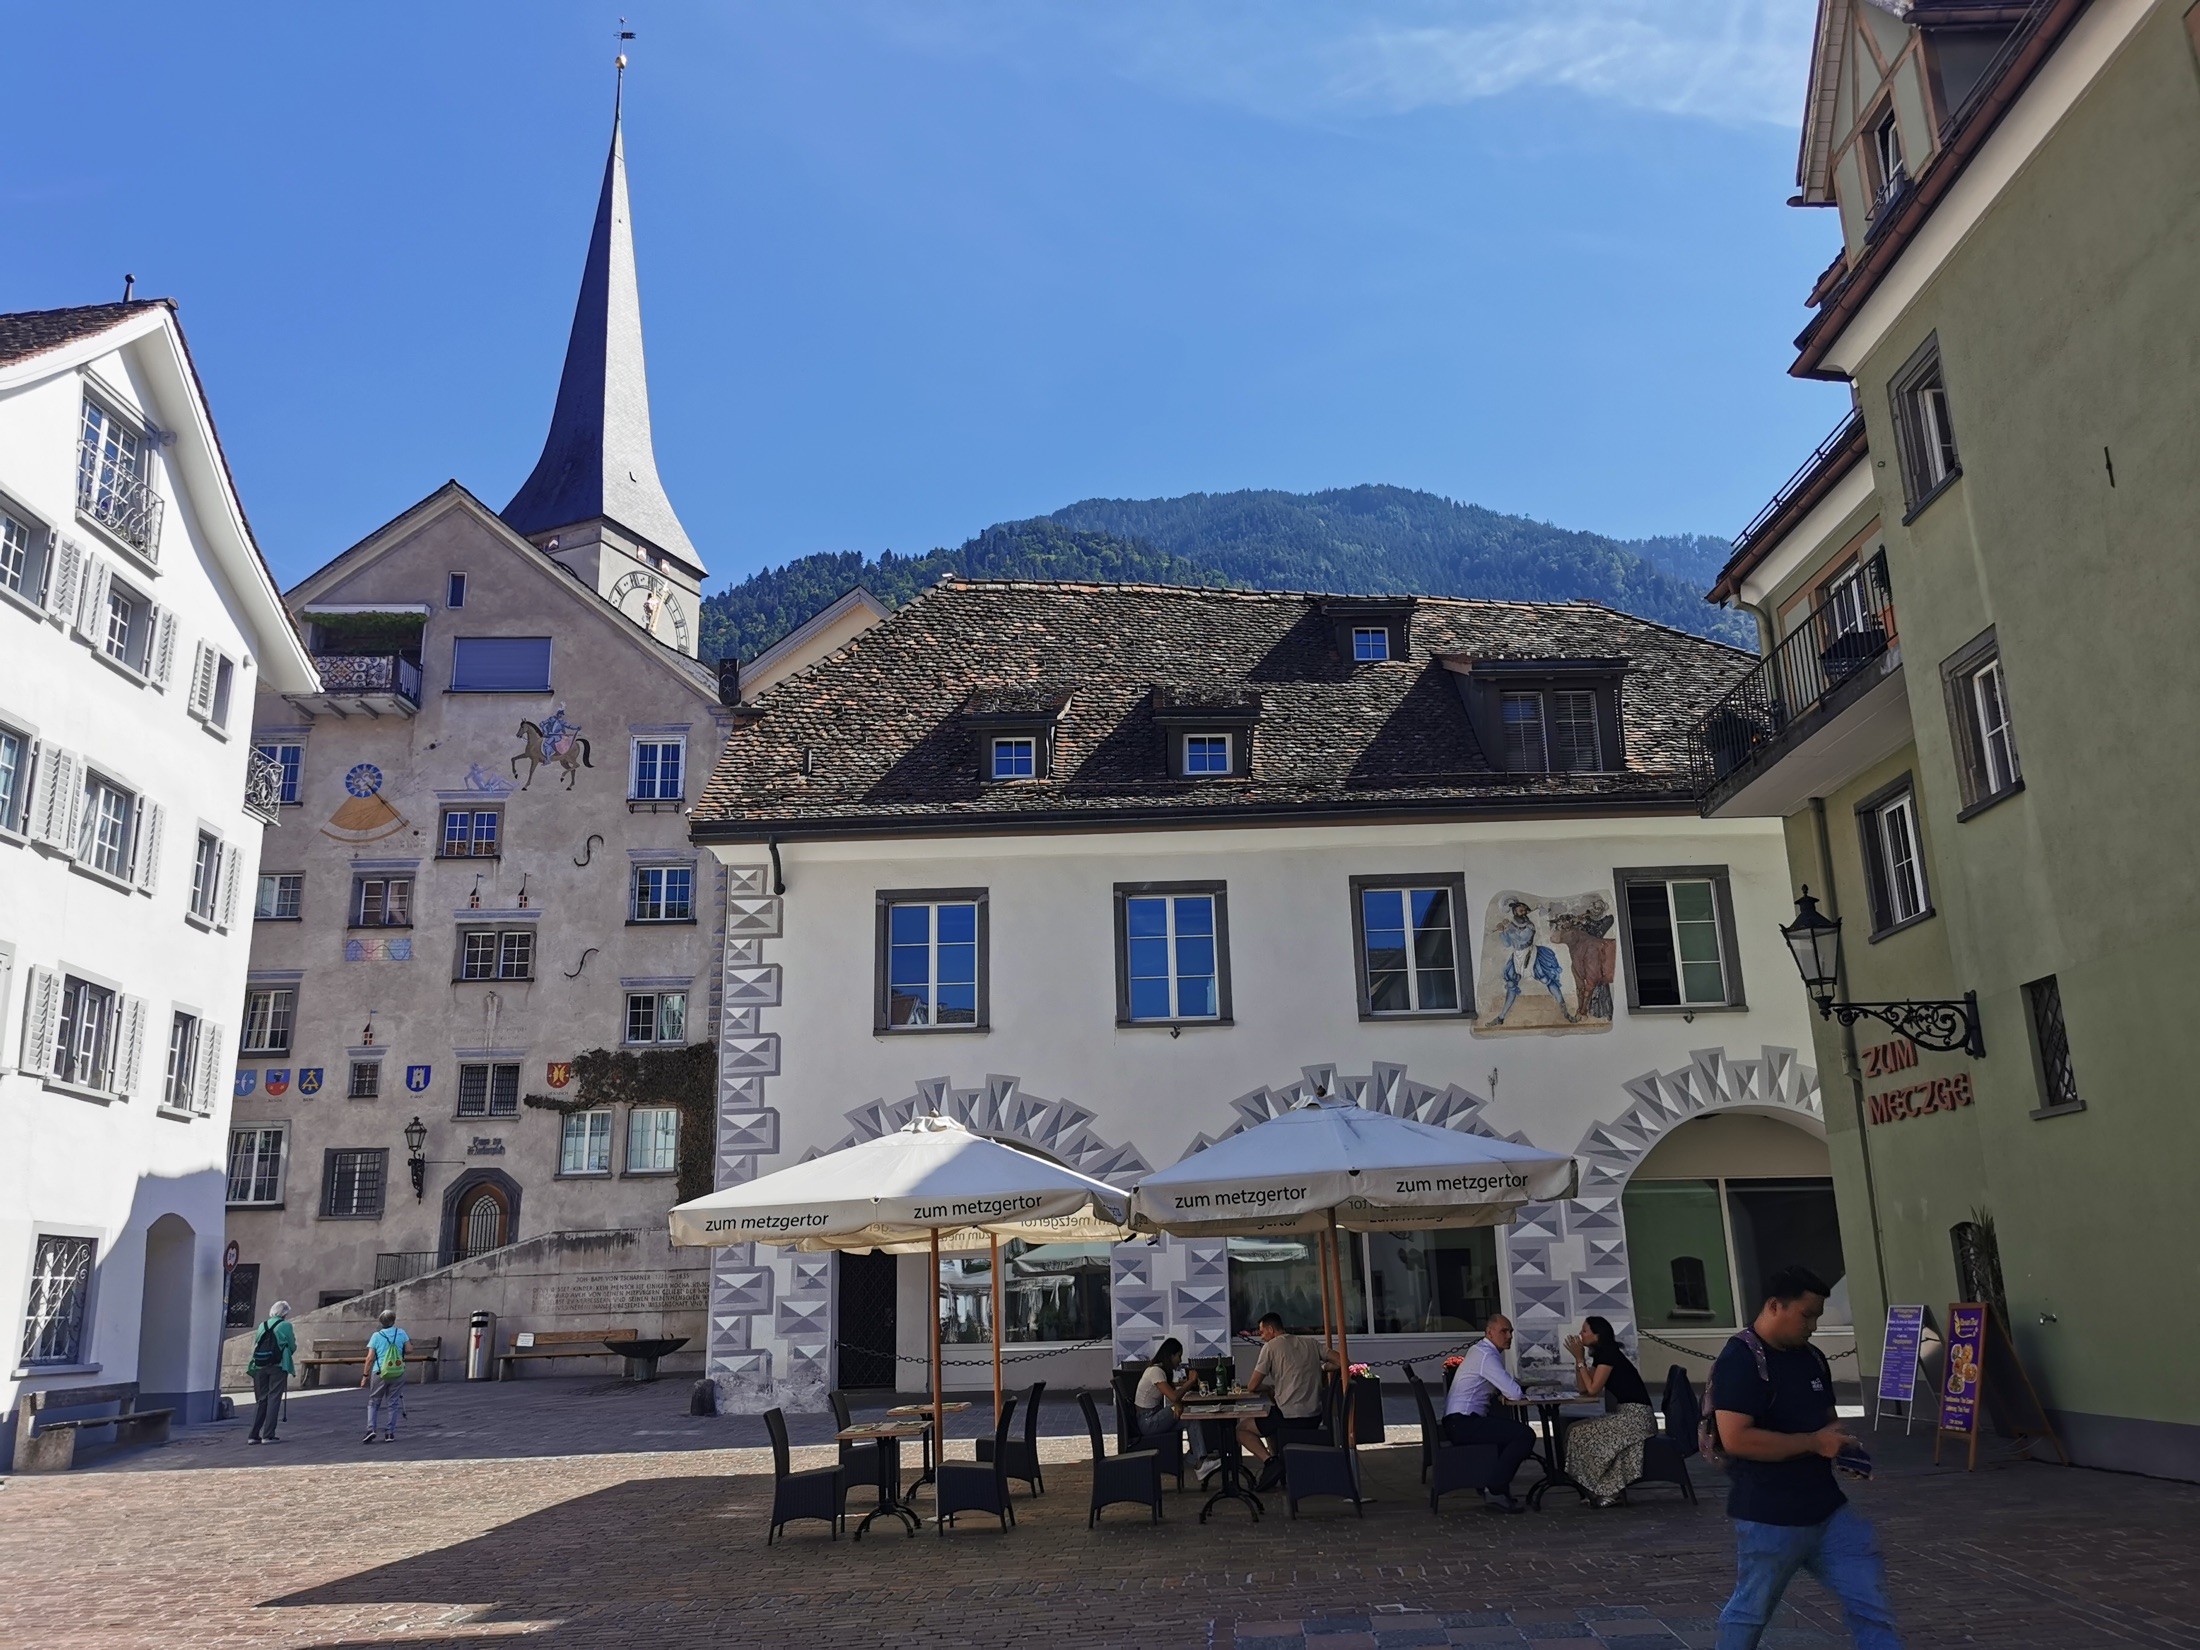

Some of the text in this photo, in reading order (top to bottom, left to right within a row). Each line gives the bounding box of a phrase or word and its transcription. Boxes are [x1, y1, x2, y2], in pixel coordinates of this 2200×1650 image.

[1861, 1039, 1918, 1078] ZUM
[1395, 1173, 1529, 1193] zum metzgertor
[913, 1195, 1043, 1219] zum metzgertor
[1174, 1186, 1307, 1209] zum metzgertor
[705, 1212, 829, 1232] zum metzgertor
